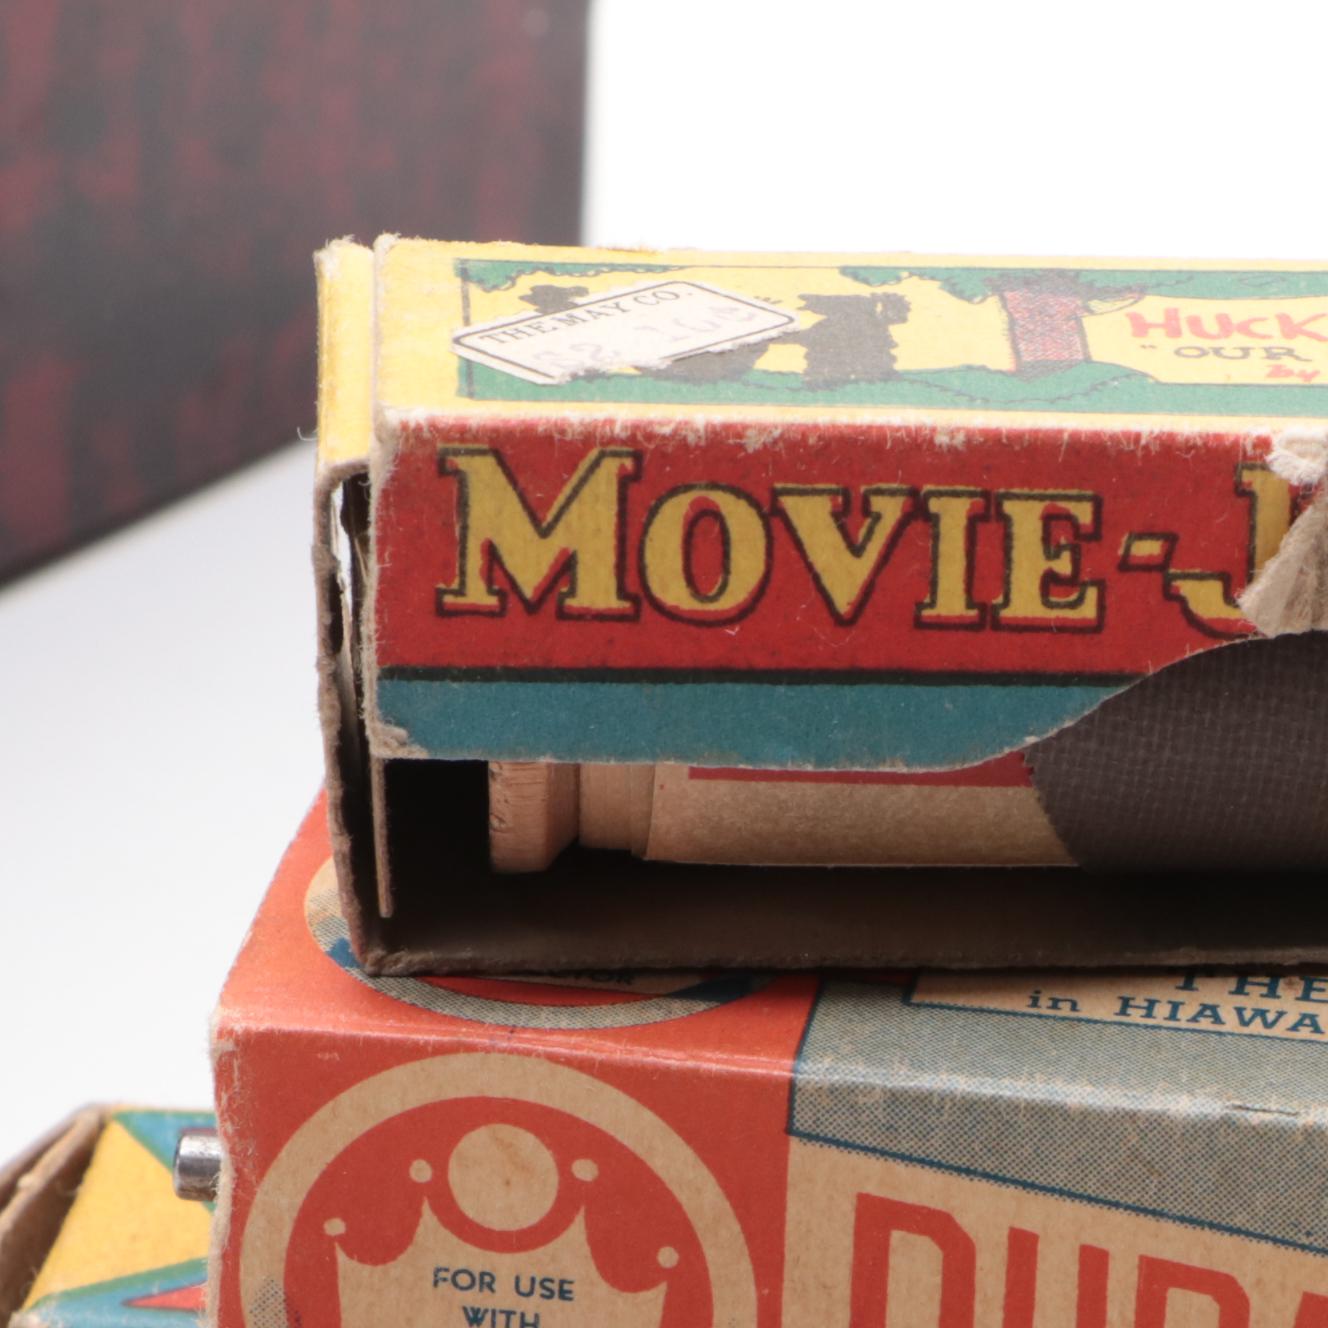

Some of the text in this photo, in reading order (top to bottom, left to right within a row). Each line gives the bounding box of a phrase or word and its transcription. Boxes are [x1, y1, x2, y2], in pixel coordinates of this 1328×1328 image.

[479, 320, 557, 345] THE
[557, 301, 632, 327] MAY
[632, 290, 694, 306] CO.
[1028, 990, 1080, 1013] in
[432, 1266, 575, 1301] FOR USE
